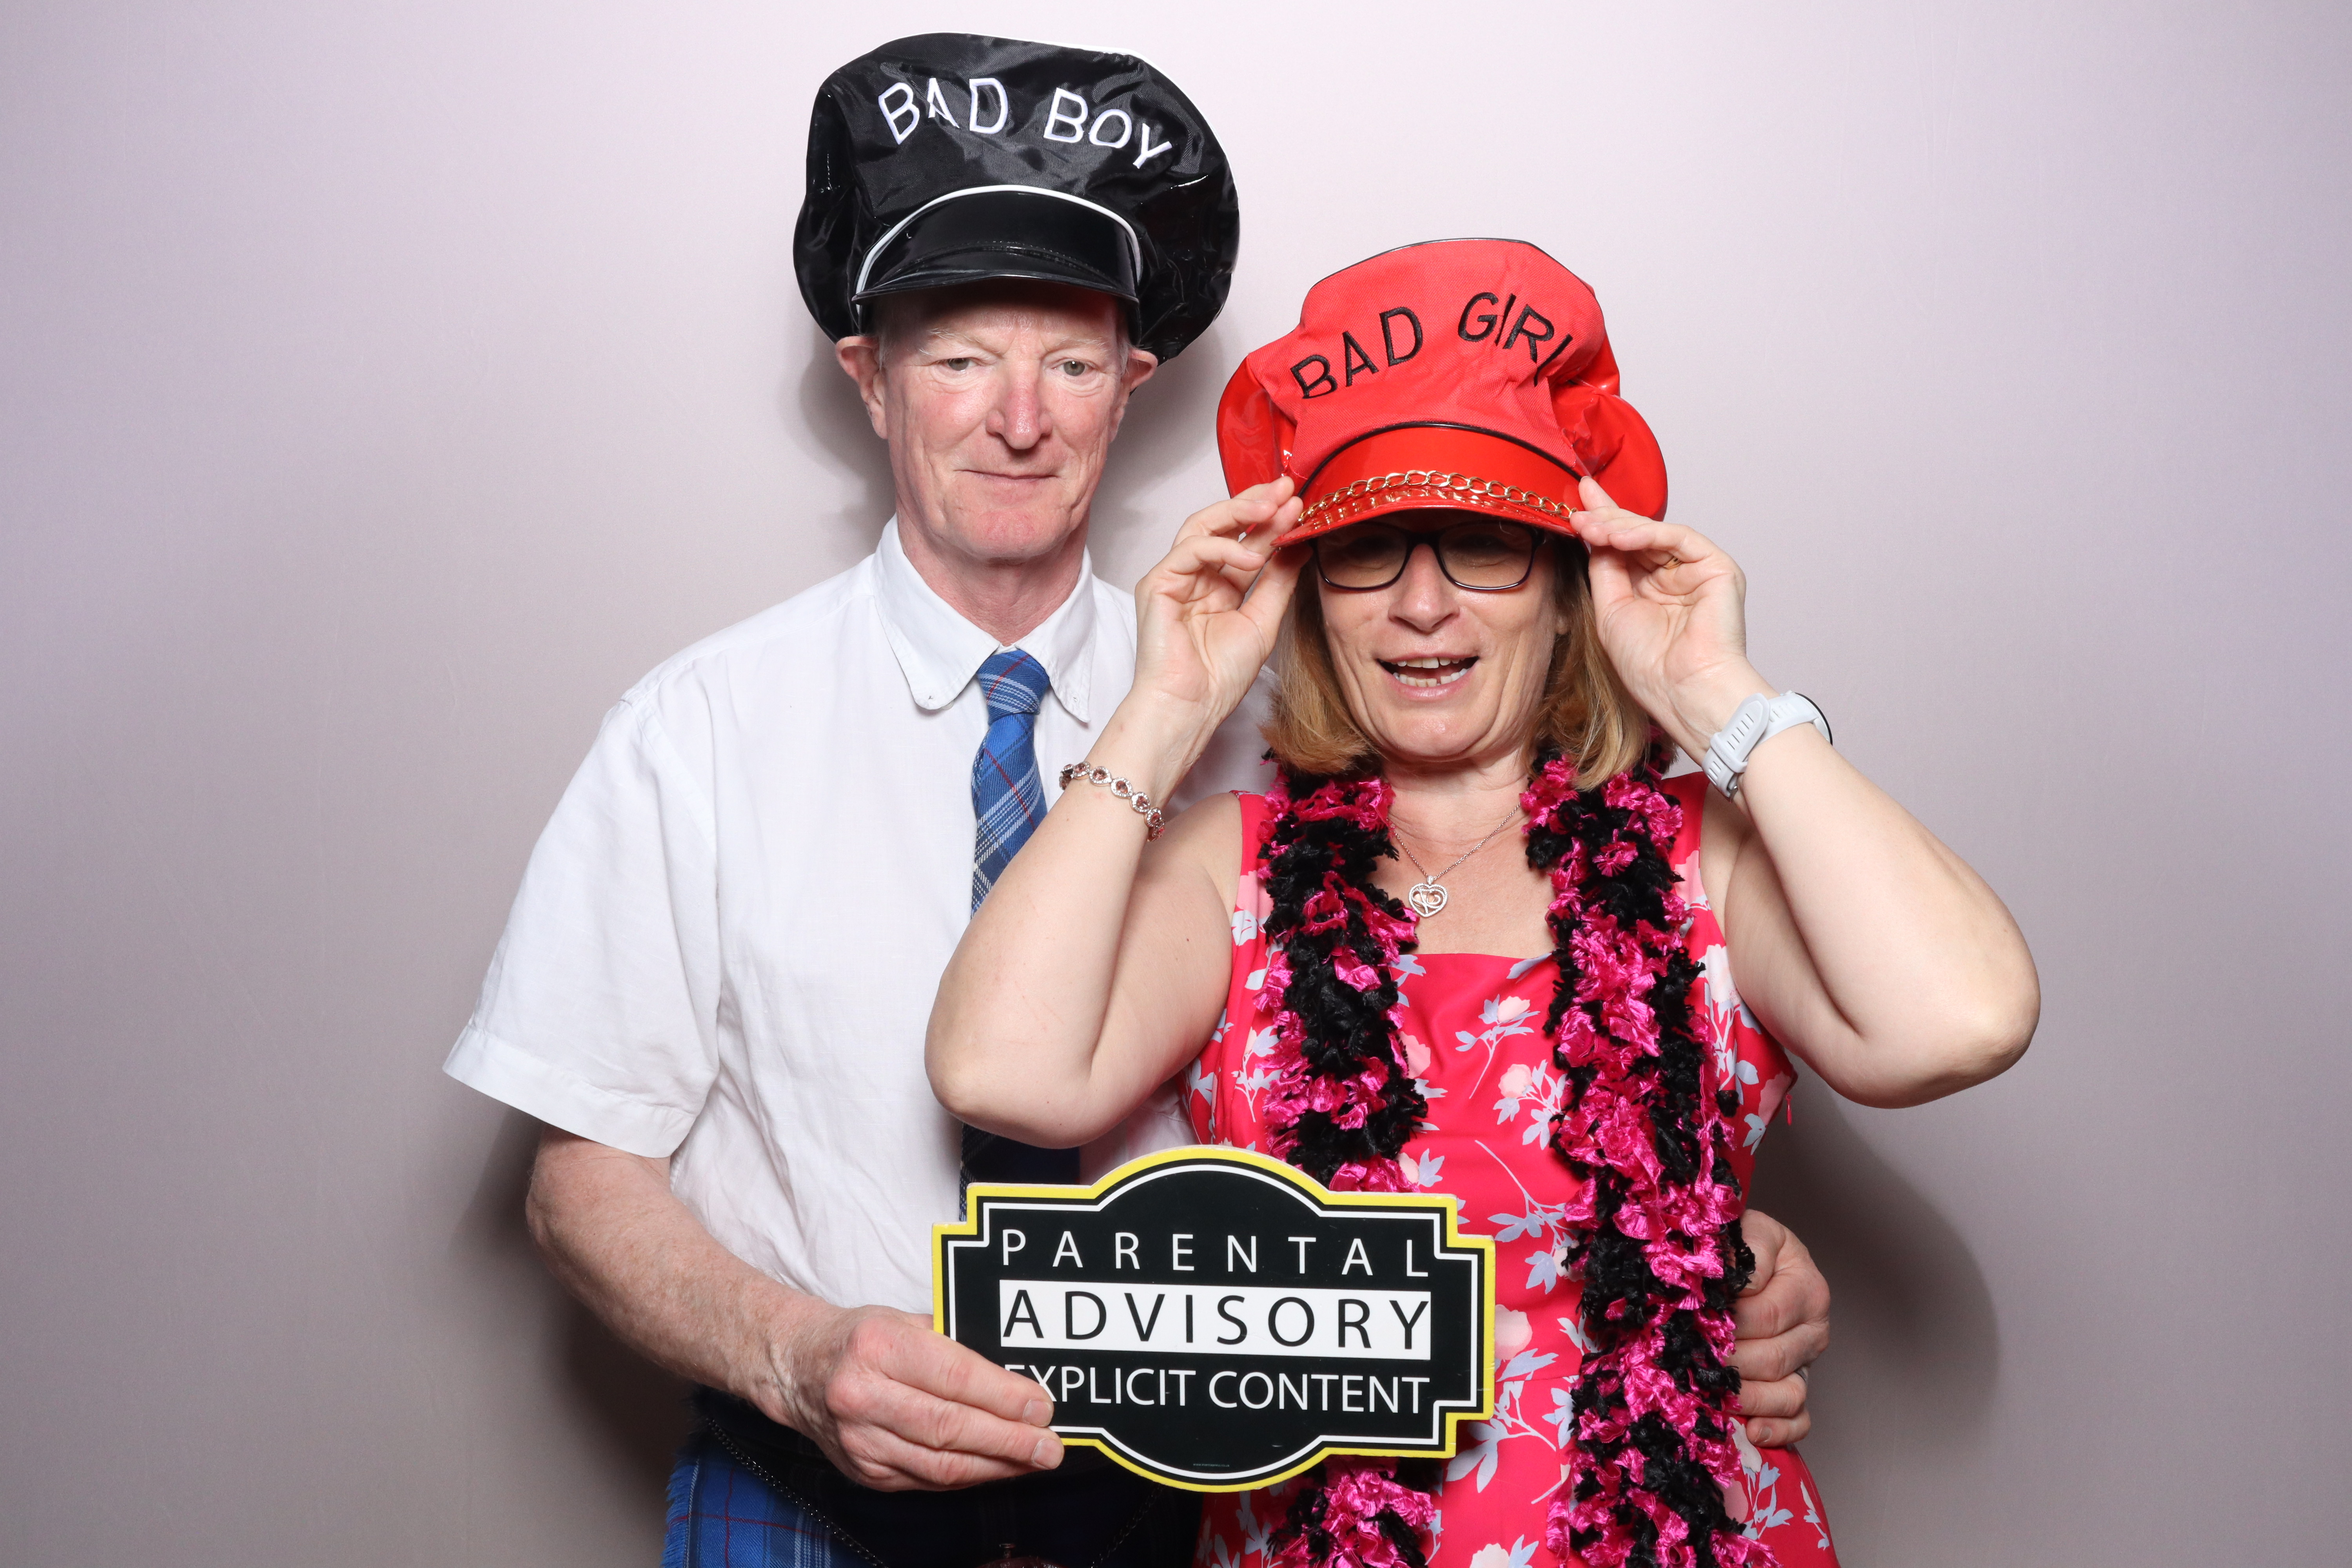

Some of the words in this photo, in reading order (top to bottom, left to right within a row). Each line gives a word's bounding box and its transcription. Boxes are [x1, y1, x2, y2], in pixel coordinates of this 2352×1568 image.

[878, 77, 1009, 145] BAD
[1043, 87, 1172, 169] BOY
[1289, 306, 1424, 399] BAD
[1002, 1229, 1429, 1278] PARENTAL
[1003, 1289, 1429, 1350] ADVISORY
[1209, 1371, 1430, 1414] CONTENT
